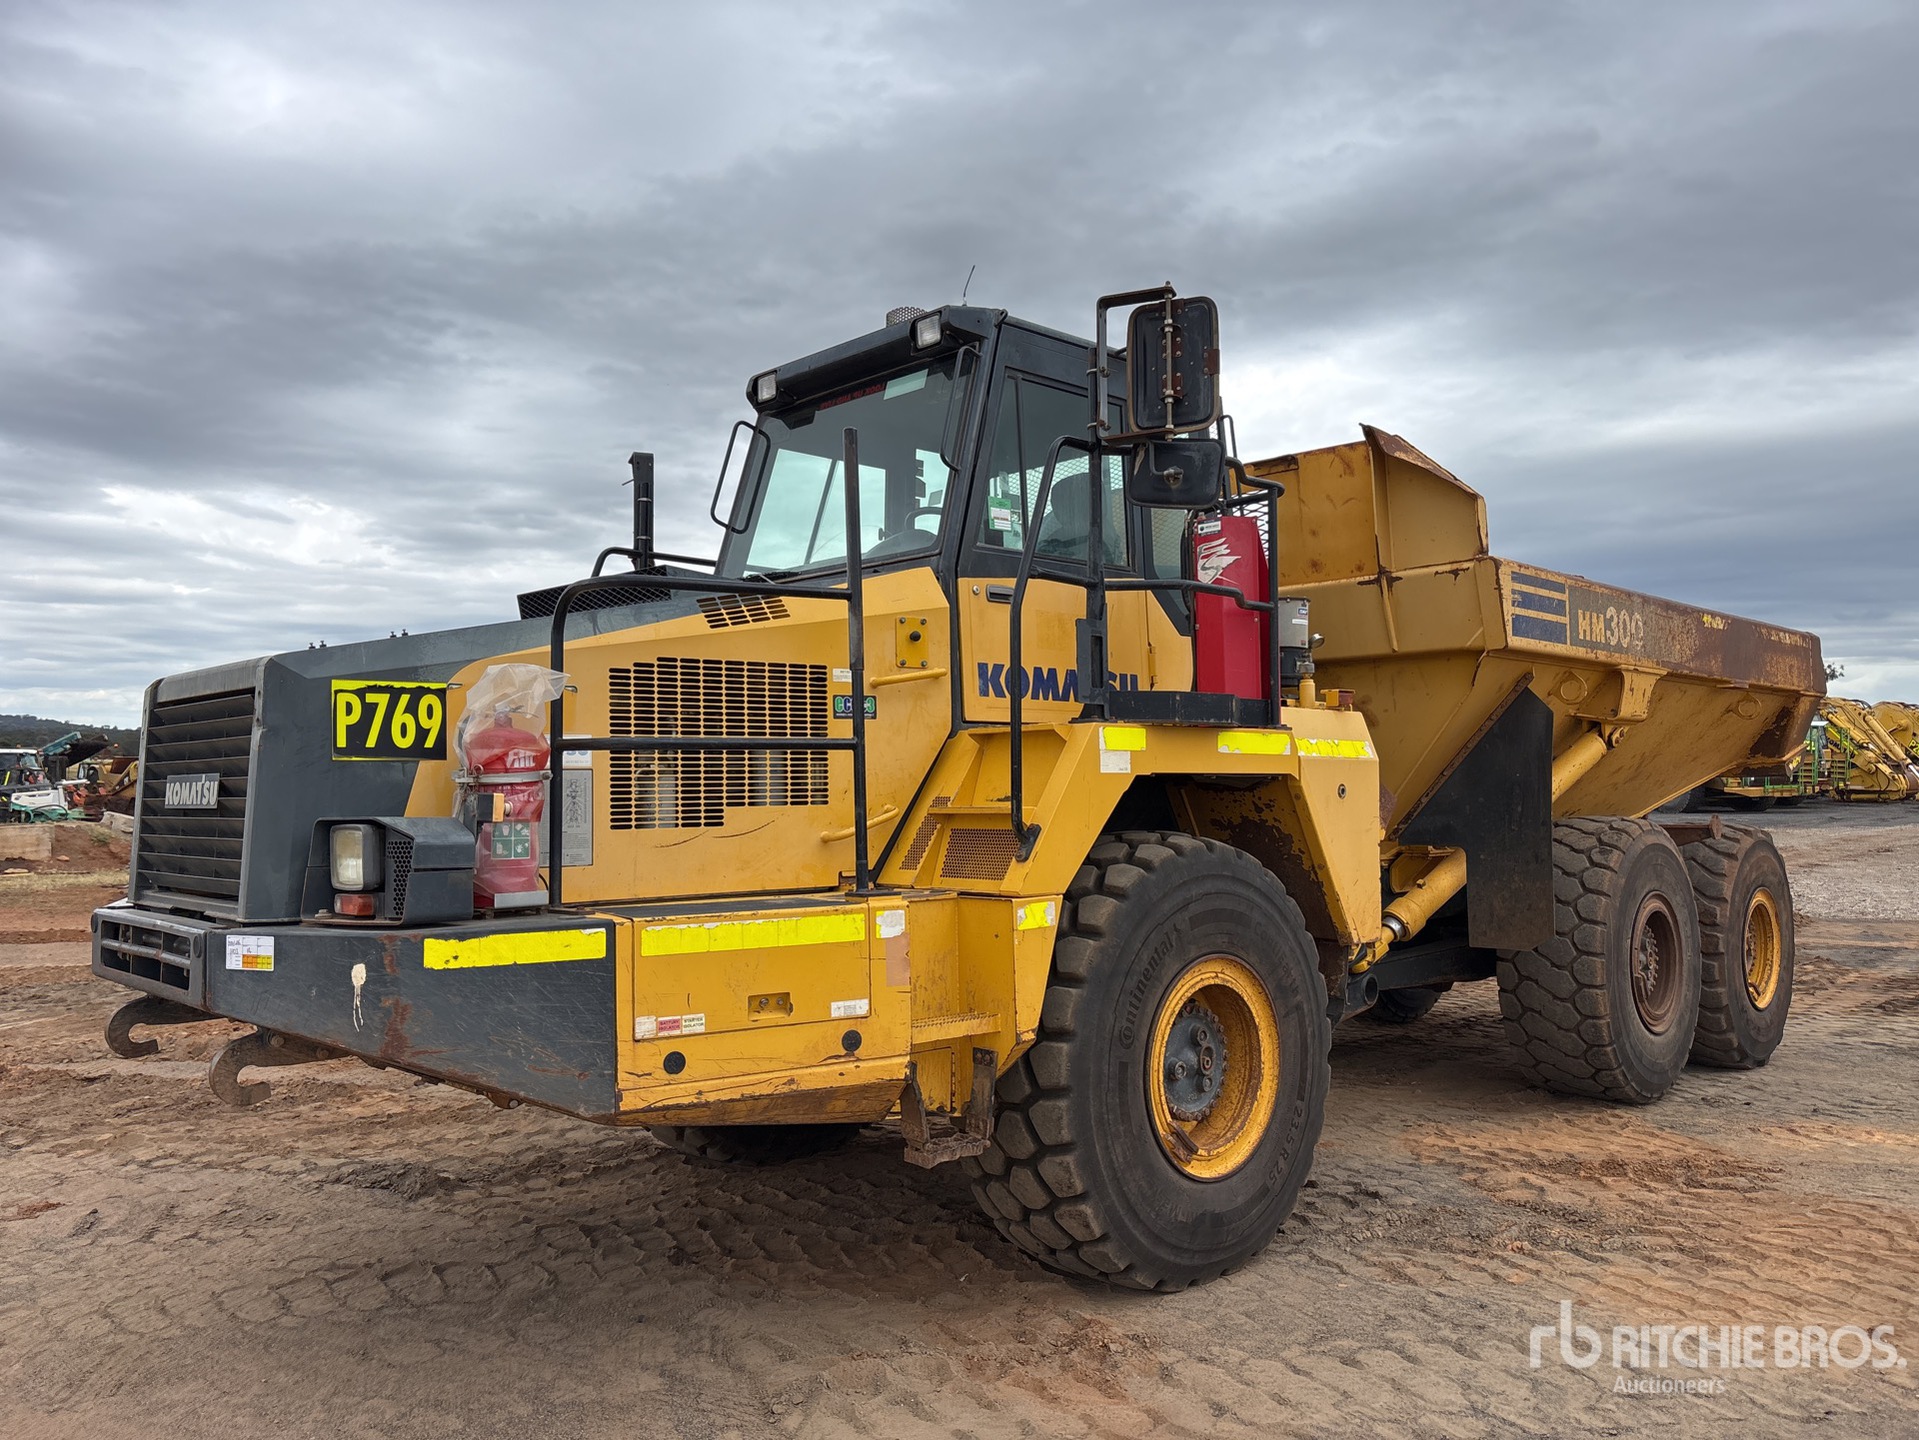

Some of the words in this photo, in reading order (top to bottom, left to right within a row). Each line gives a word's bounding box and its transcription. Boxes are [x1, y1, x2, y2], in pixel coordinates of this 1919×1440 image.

[336, 692, 443, 749] P769
[165, 774, 219, 806] KOMATSU
[1119, 930, 1174, 1051] Continental
